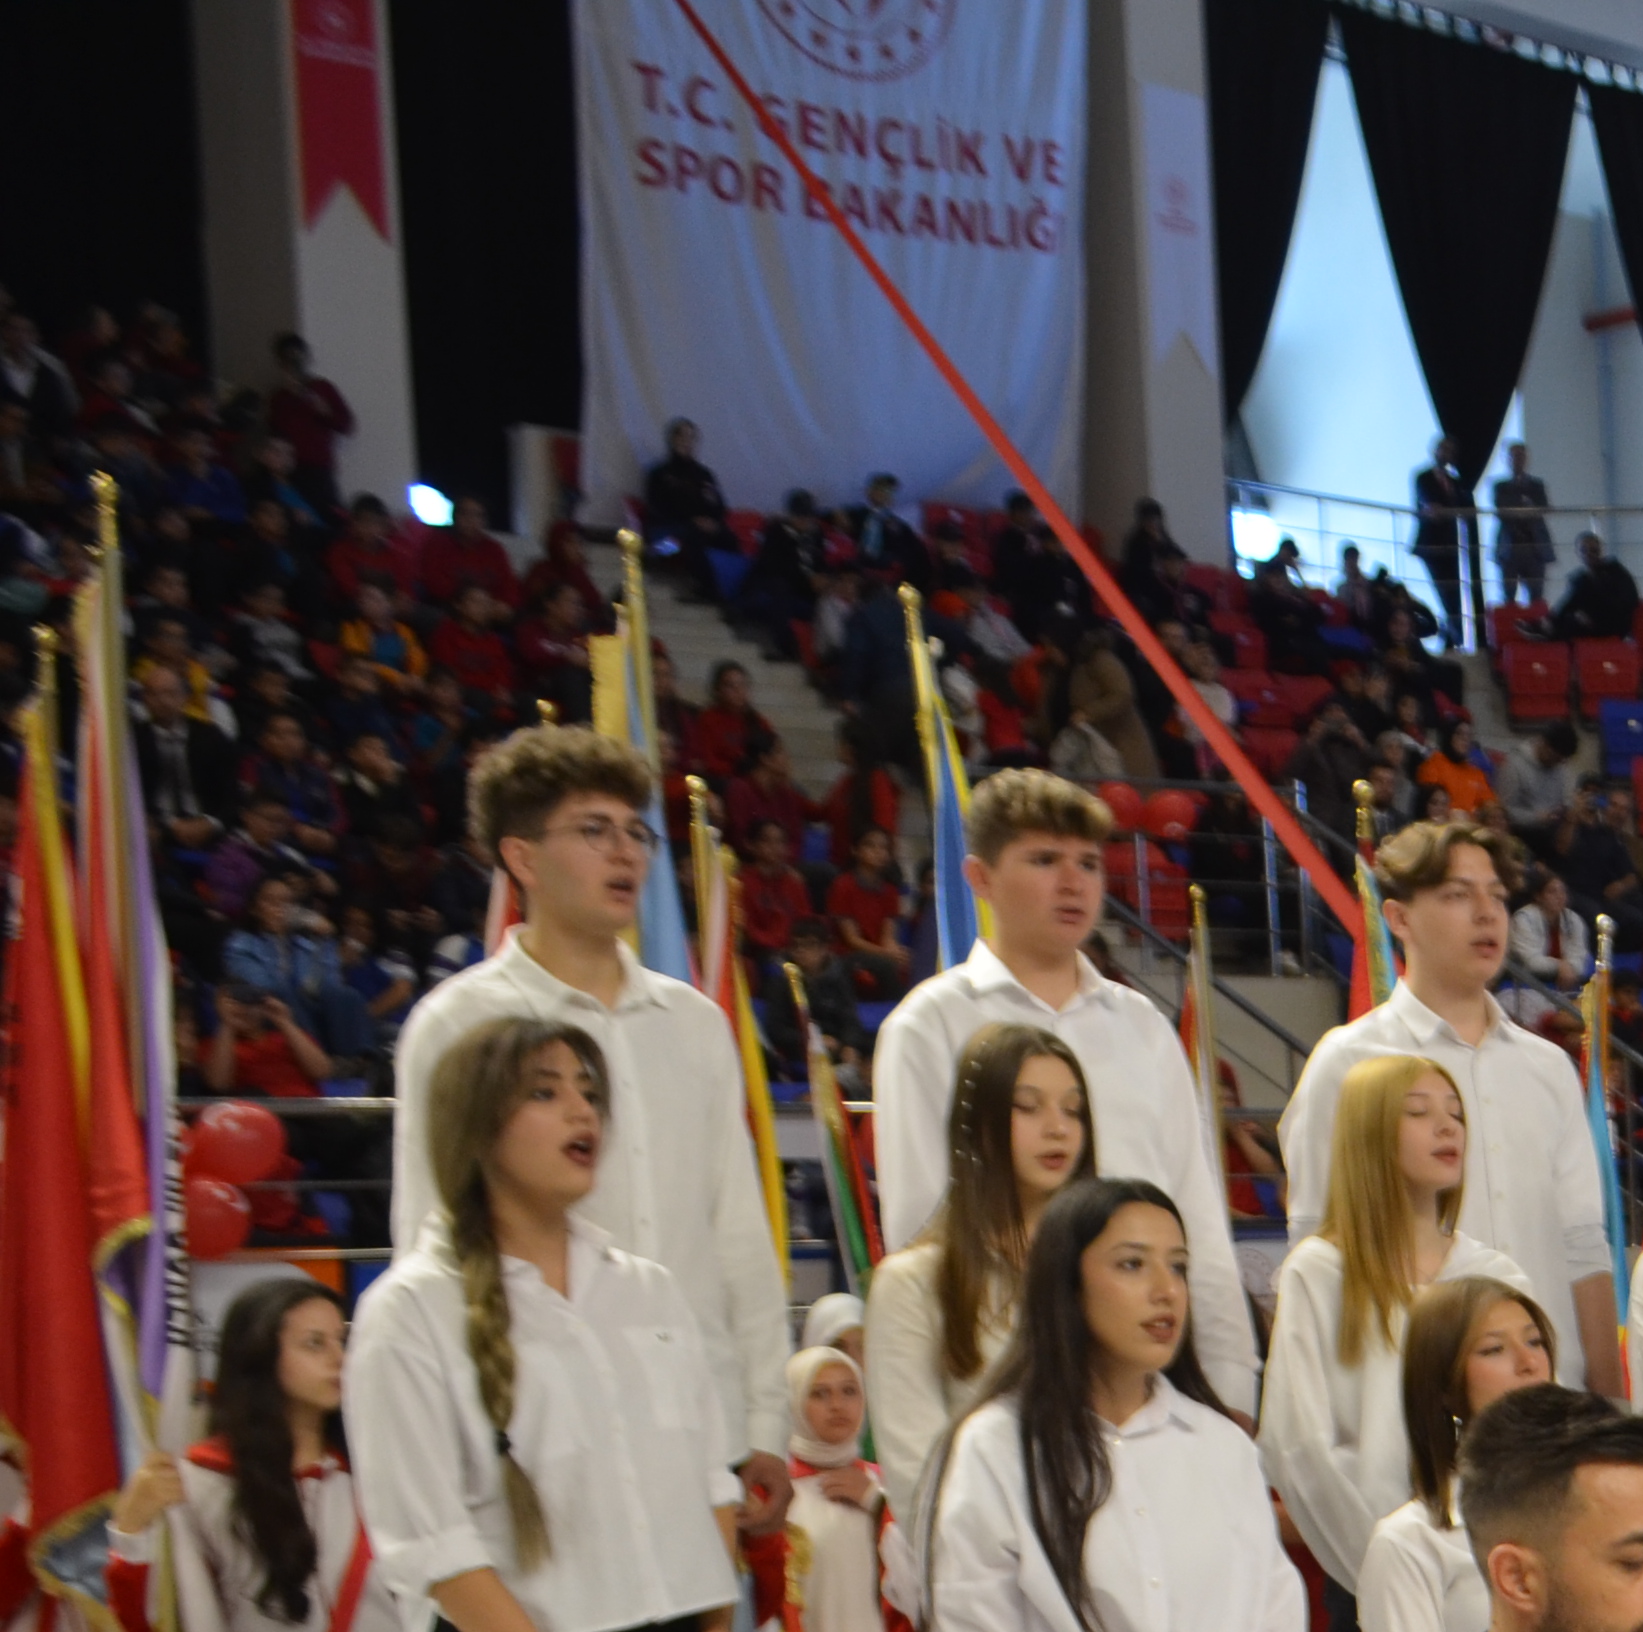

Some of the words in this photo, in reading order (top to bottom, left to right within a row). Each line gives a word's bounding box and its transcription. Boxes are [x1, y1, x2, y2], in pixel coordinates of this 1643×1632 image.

[631, 60, 735, 134] T.C.
[1001, 132, 1064, 187] VE
[634, 137, 786, 216] SPOR
